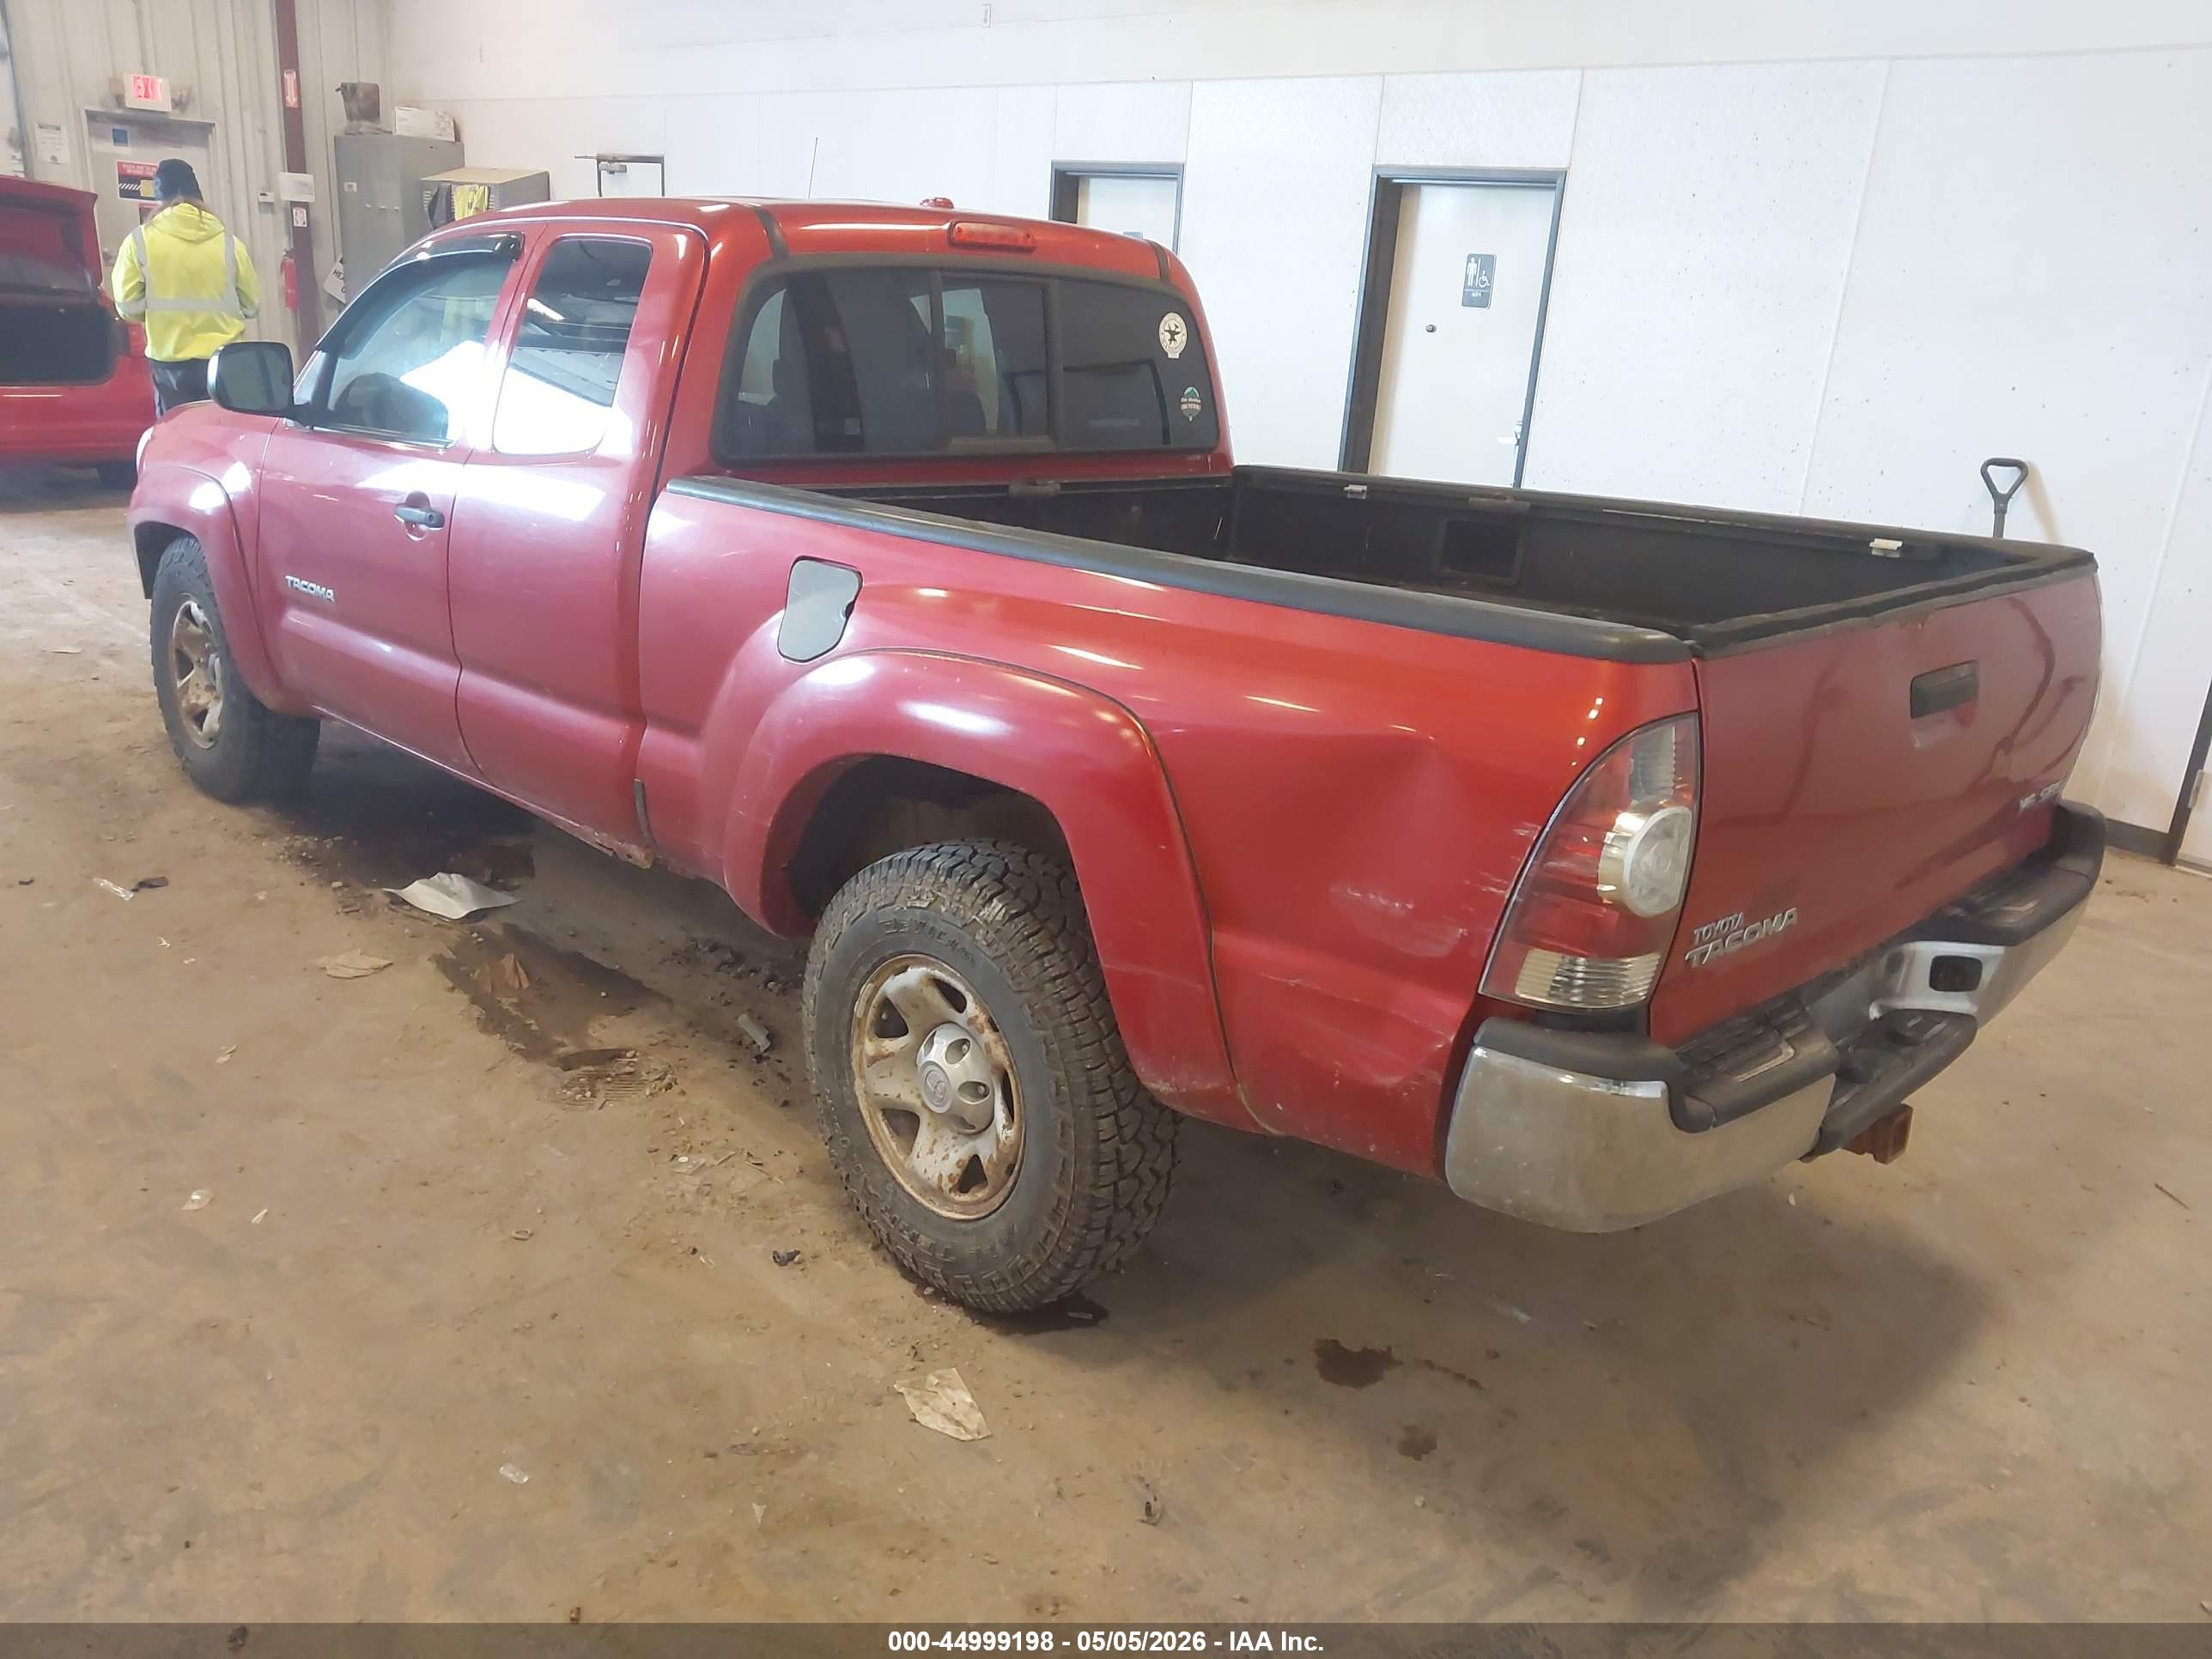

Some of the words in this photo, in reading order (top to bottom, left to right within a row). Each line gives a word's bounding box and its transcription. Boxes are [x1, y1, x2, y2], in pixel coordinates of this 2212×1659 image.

[131, 76, 163, 100] EXIT
[285, 574, 336, 602] TACOMA
[1685, 907, 1798, 969] TACOMA
[1693, 911, 1746, 945] TOYOTA
